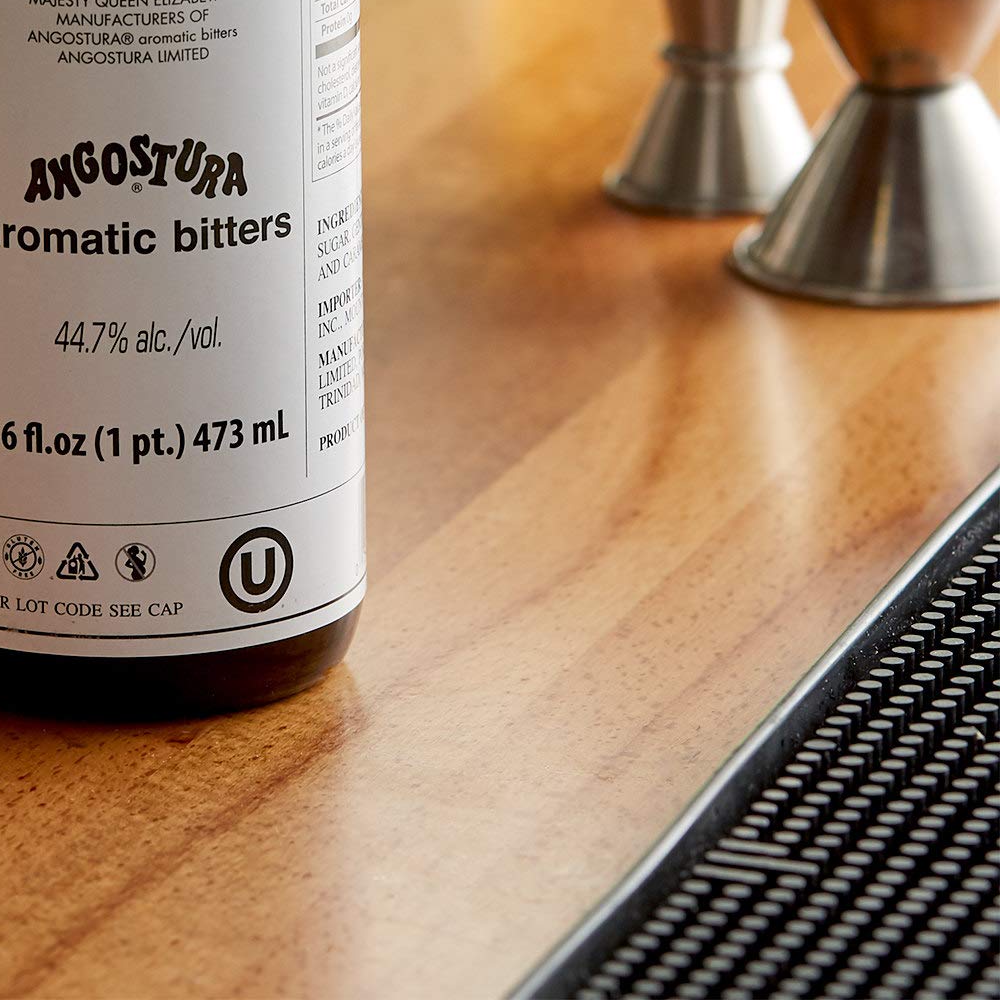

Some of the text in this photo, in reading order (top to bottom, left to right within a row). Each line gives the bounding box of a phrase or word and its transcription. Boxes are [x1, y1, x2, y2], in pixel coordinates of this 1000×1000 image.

[56, 9, 209, 27] MANUFACTURERS OF
[27, 27, 238, 46] ANGOSTURA® aromatic bitters
[57, 47, 209, 65] ANGOSTURA LIMITED
[24, 134, 248, 203] ANGOSTURA
[173, 211, 292, 253] bitters
[317, 258, 340, 281] AND
[54, 315, 222, 356] 44.7% alc./vol.
[23, 421, 87, 456] fl.oz
[94, 425, 121, 462] (1
[132, 423, 186, 465] pt.)
[193, 418, 244, 453] 473
[252, 409, 289, 446] mL
[16, 598, 49, 615] LOT
[54, 601, 103, 618] CODE
[109, 602, 142, 619] SEE
[149, 601, 184, 617] CAP
